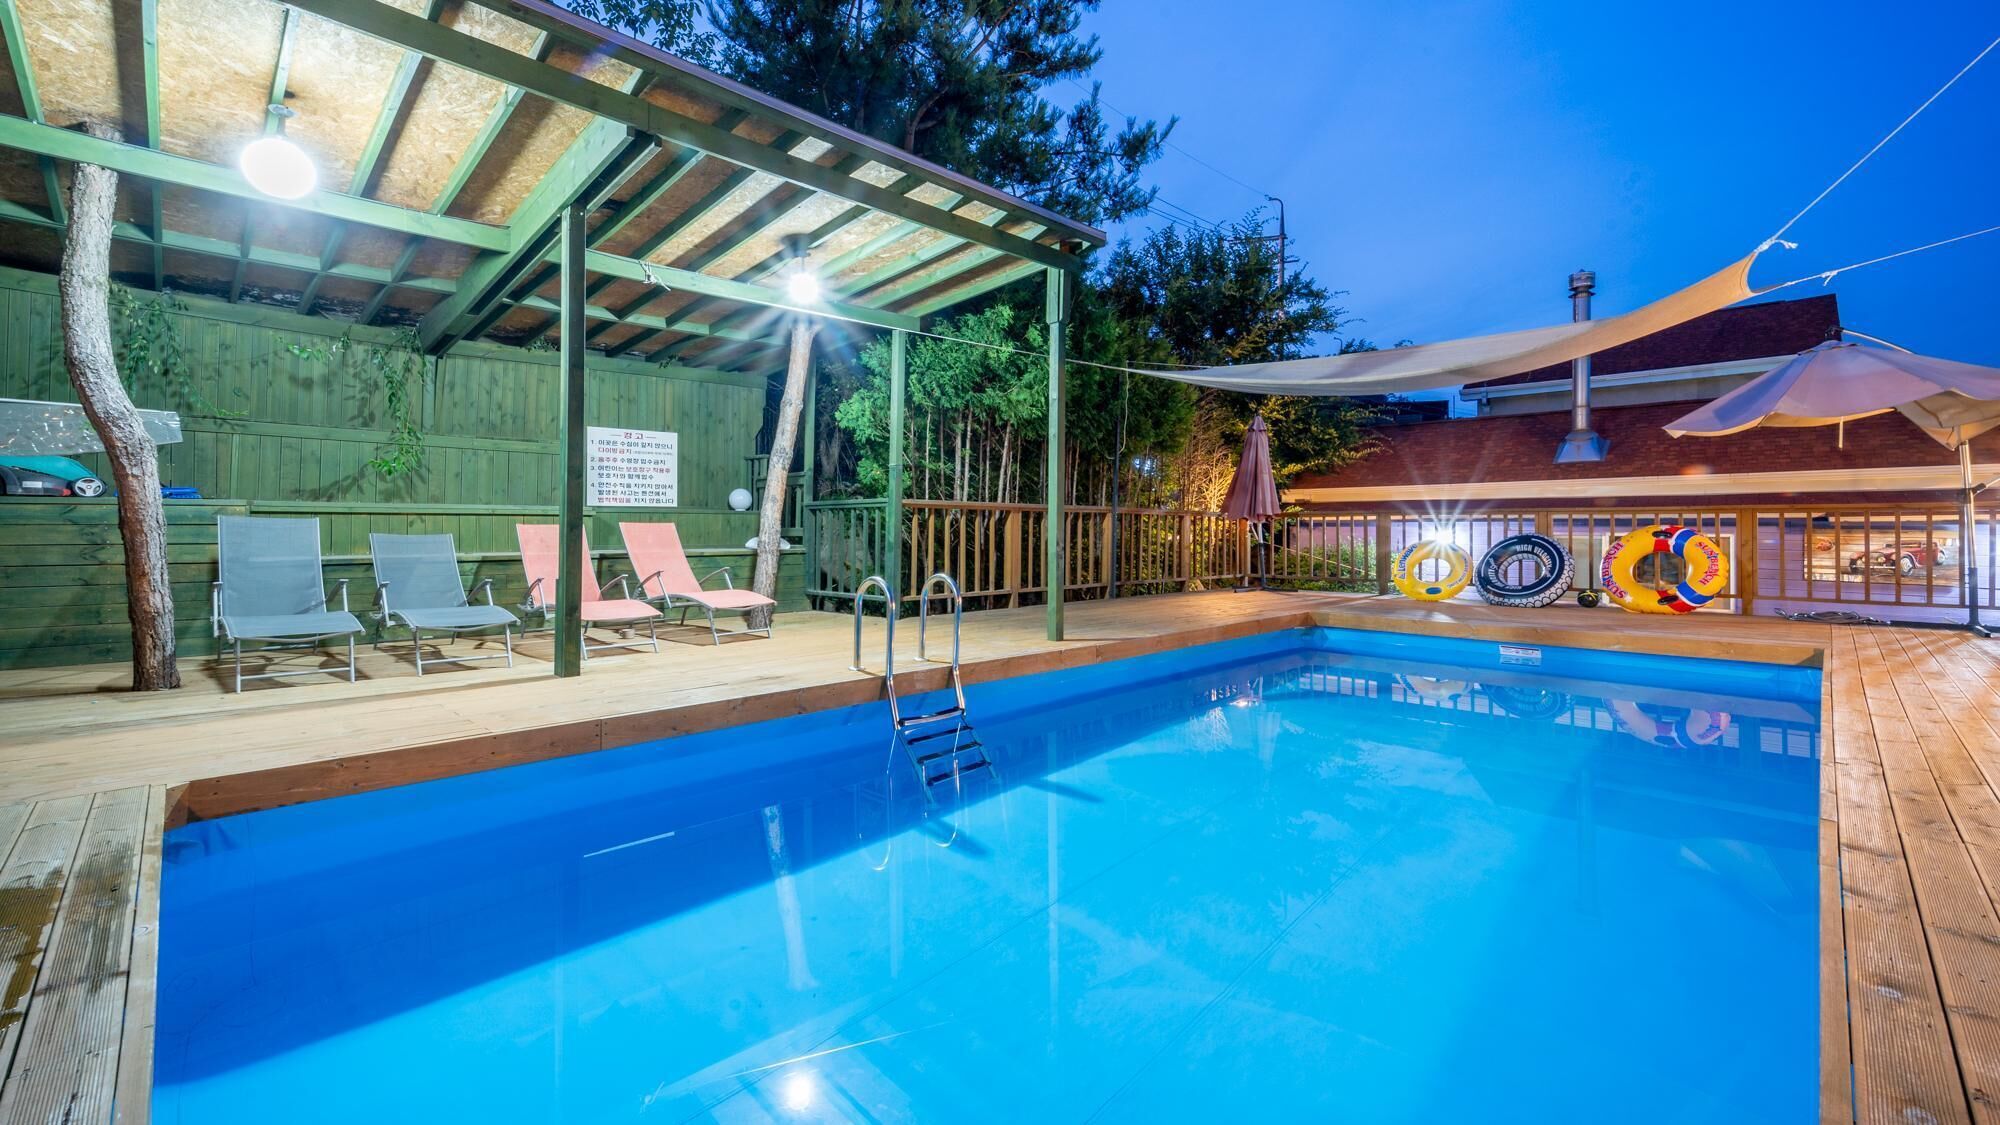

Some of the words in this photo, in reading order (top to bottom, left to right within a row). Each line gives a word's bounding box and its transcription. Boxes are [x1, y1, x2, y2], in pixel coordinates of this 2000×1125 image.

[1515, 544, 1533, 552] HIGH
[1534, 545, 1553, 571] VELOCITY
[1602, 575, 1627, 599] SUN
